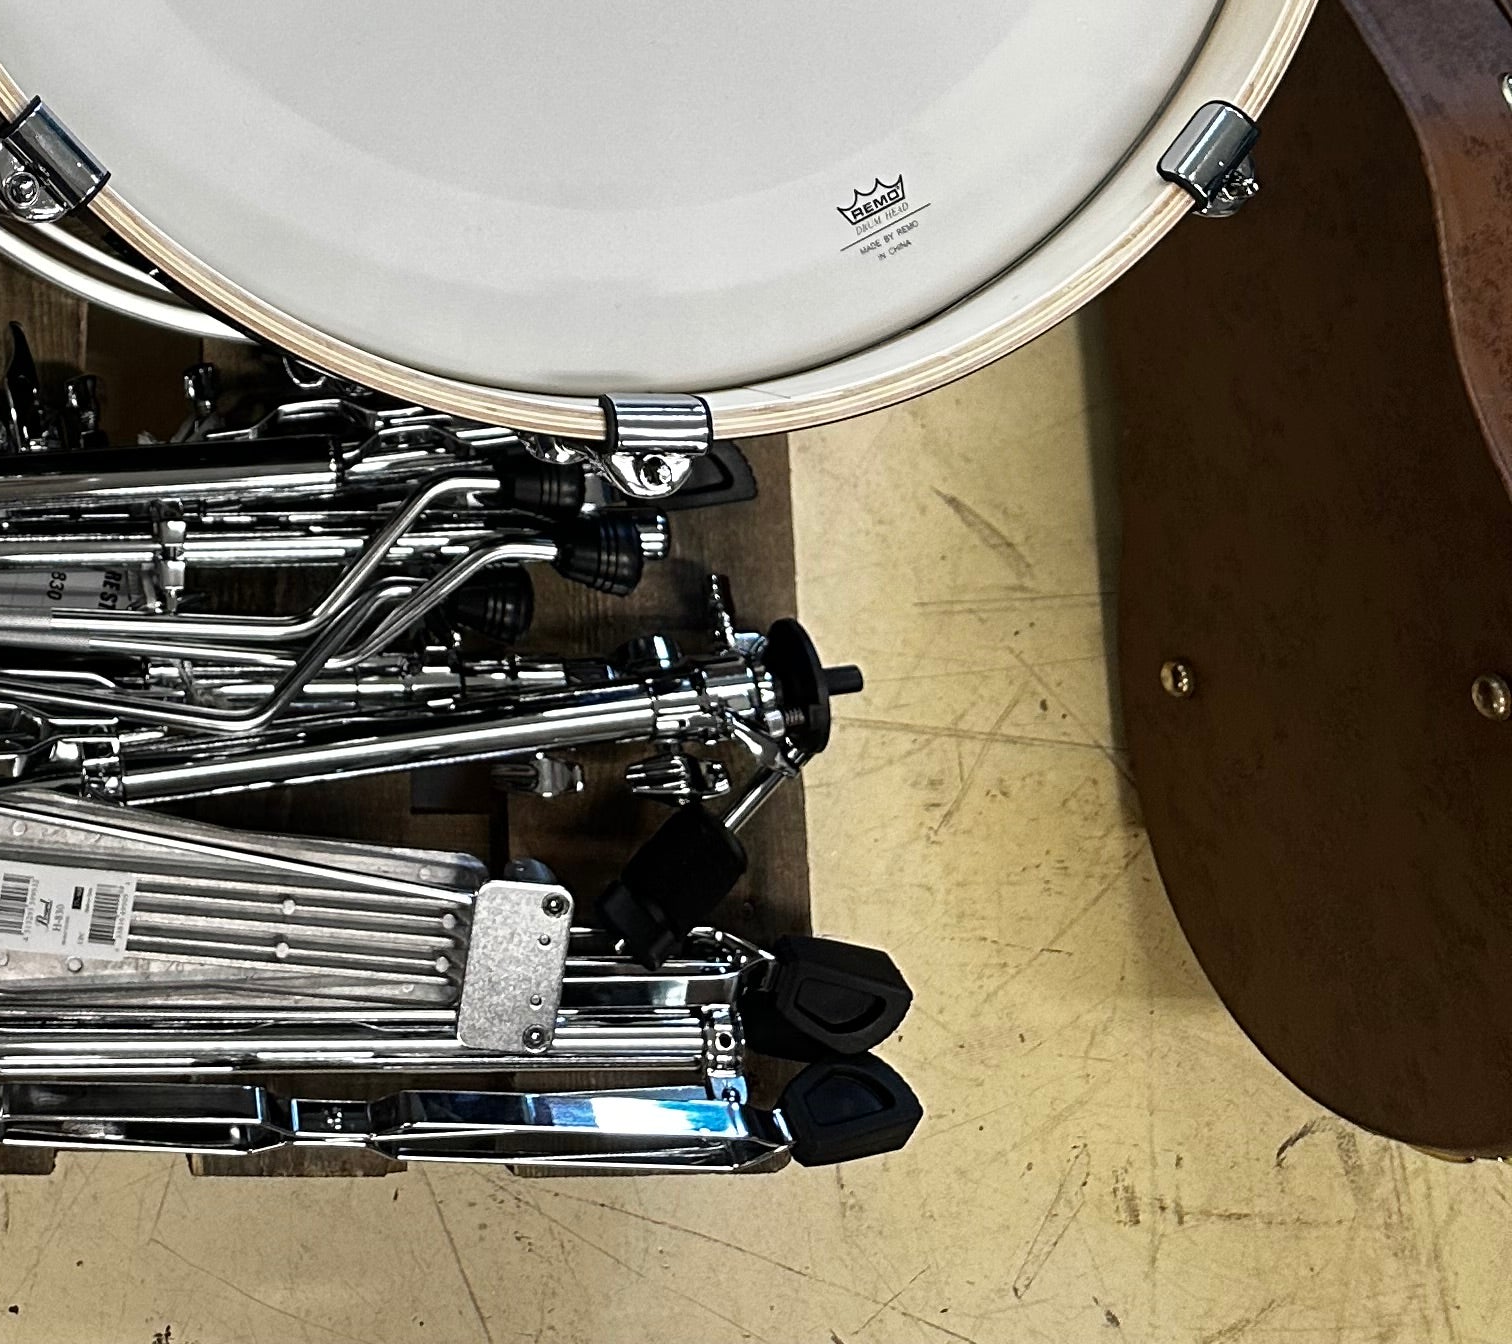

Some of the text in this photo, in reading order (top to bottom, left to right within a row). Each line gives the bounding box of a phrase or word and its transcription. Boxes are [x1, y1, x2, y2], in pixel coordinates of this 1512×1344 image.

[851, 188, 900, 219] REMO
[855, 201, 909, 236] DRUM HEAD
[859, 219, 919, 255] MADE BY REMO
[877, 239, 912, 261] IN CHINA
[46, 570, 67, 601] 830
